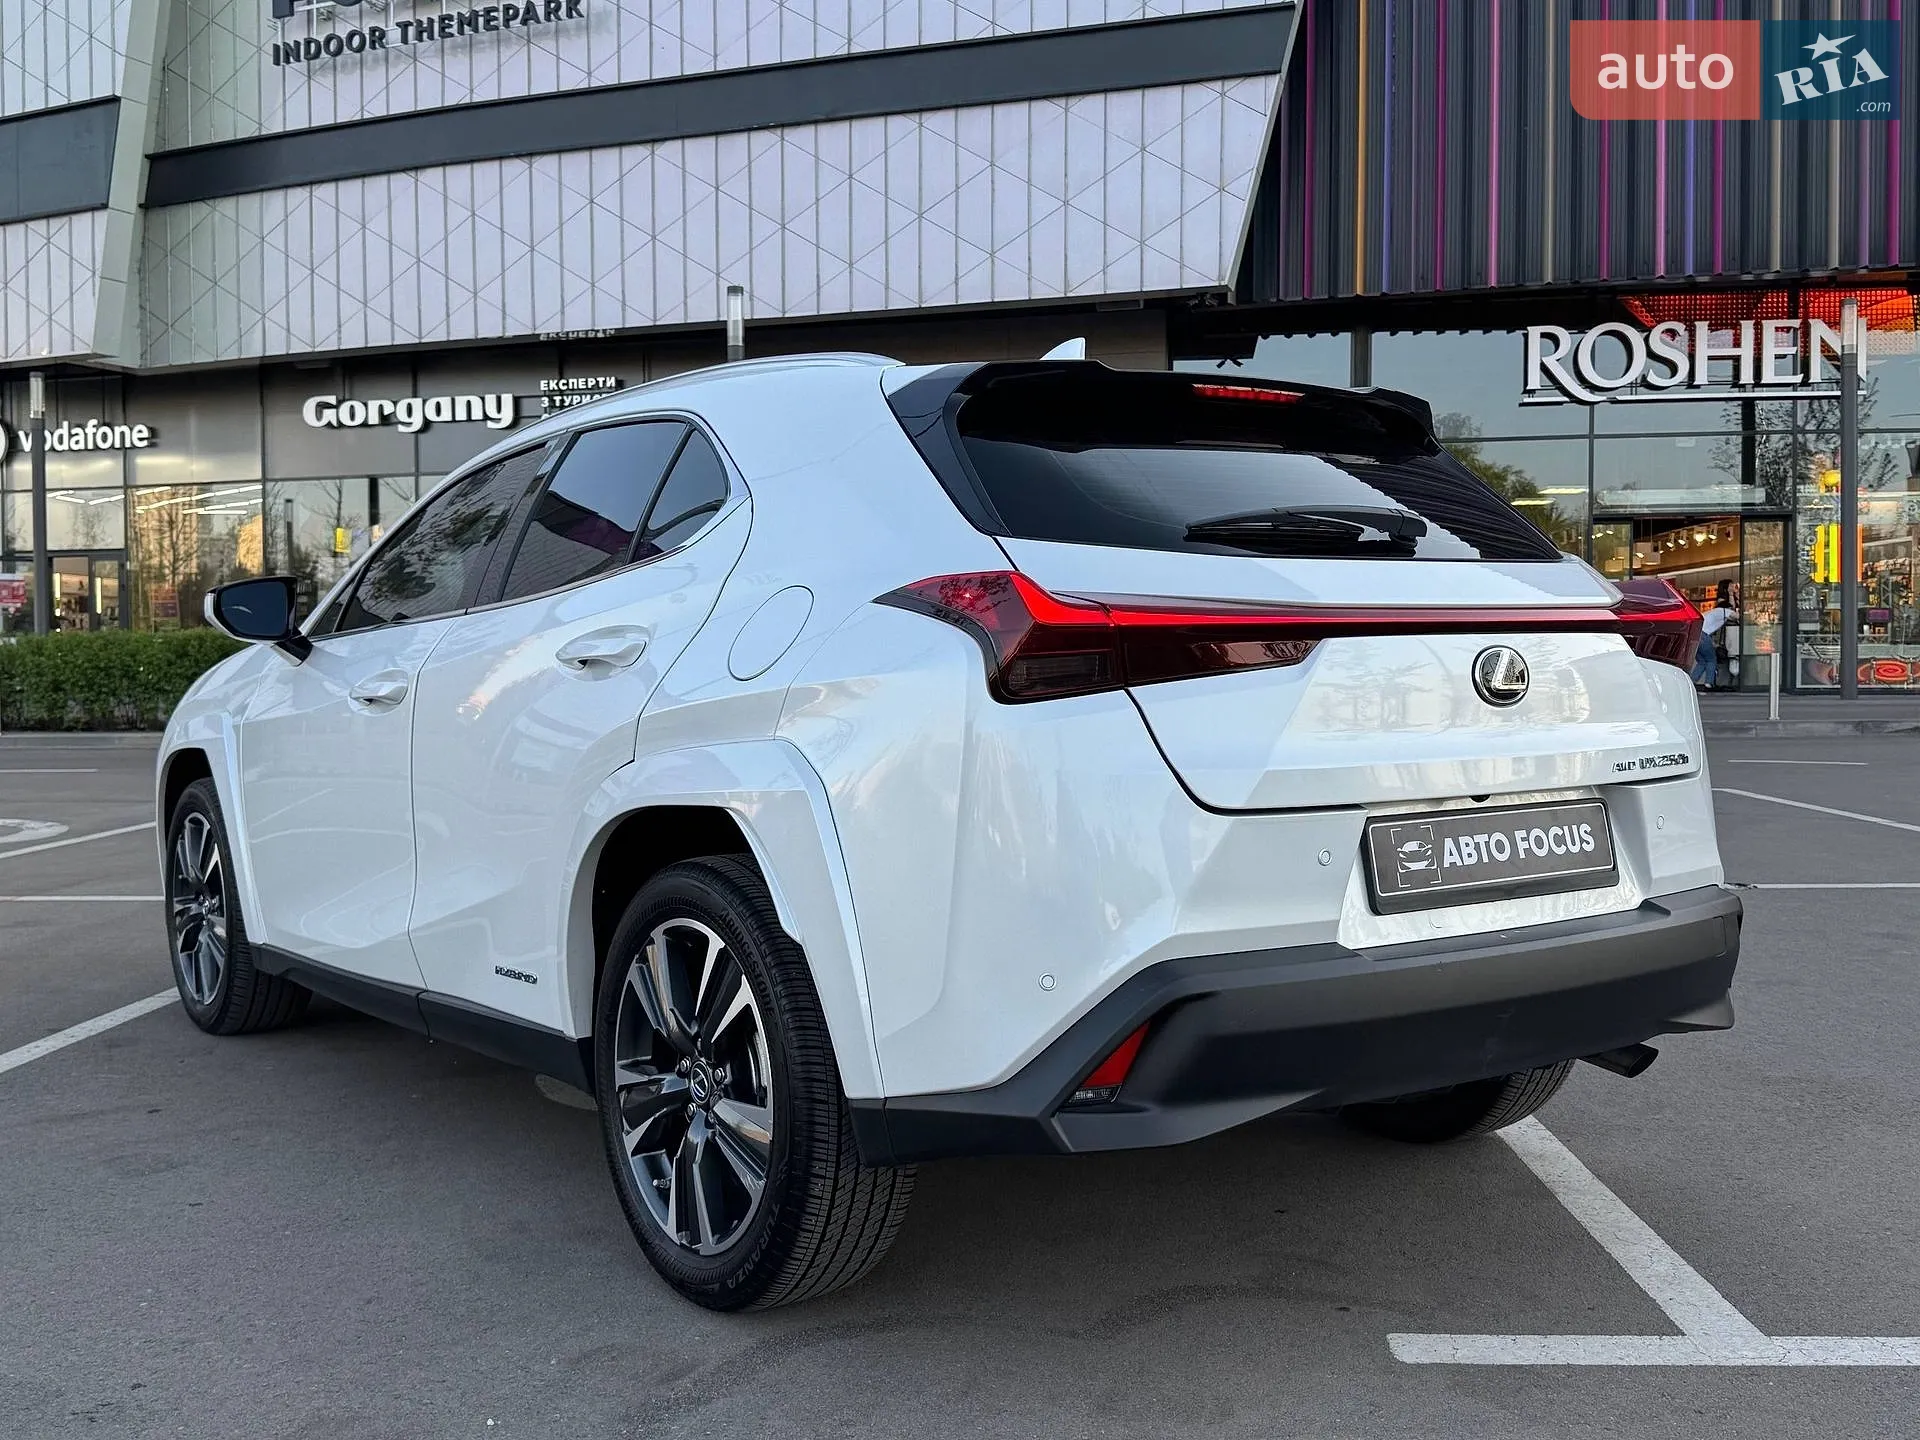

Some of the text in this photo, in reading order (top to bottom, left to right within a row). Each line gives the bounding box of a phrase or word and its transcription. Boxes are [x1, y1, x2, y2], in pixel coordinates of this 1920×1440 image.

[272, 25, 386, 66] INDOOR
[395, 0, 585, 45] THEMEPARK
[1526, 318, 1867, 401] ROSHEN
[540, 376, 616, 391] ЕКСПЕРТИ
[303, 393, 513, 433] Gorgany
[1514, 823, 1595, 859] FOCUS
